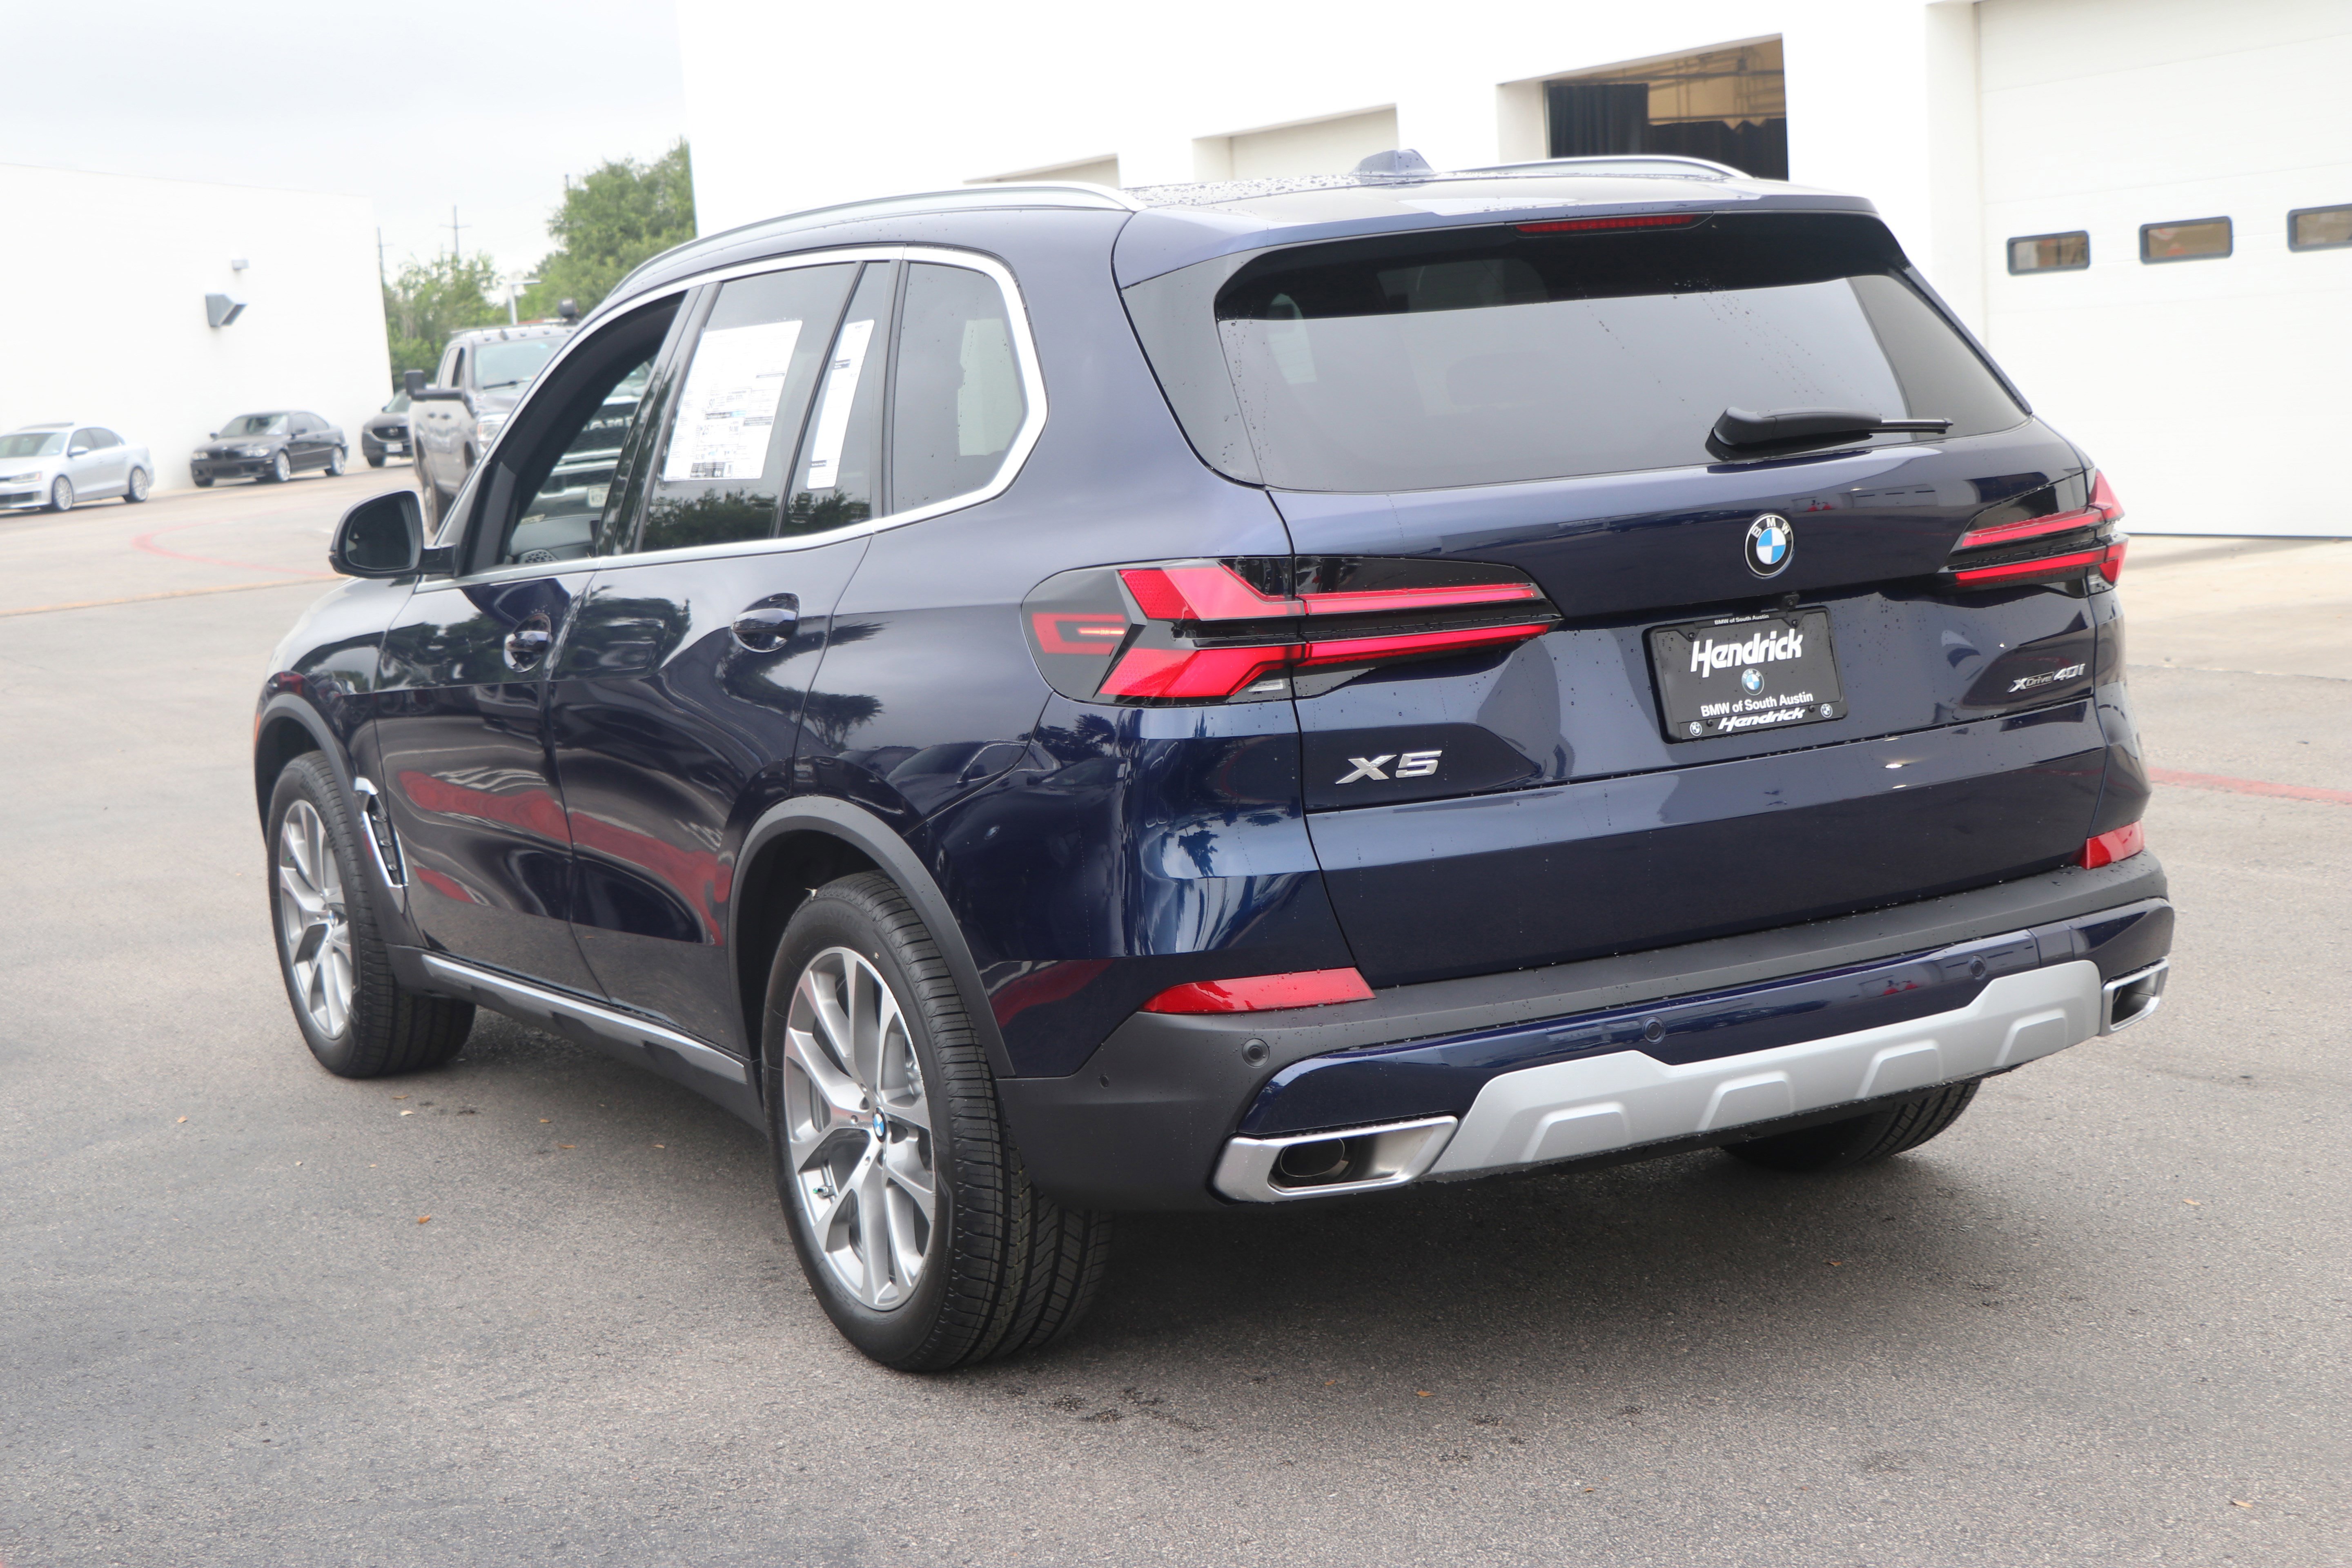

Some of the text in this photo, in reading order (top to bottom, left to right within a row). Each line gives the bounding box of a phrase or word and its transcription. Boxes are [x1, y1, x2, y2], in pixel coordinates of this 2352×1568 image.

[1751, 517, 1790, 538] BMW
[1689, 628, 1804, 678] Hendrick
[1700, 691, 1813, 717] BMW of South Austin
[1717, 707, 1806, 732] Hendrick
[1334, 750, 1443, 784] X5
